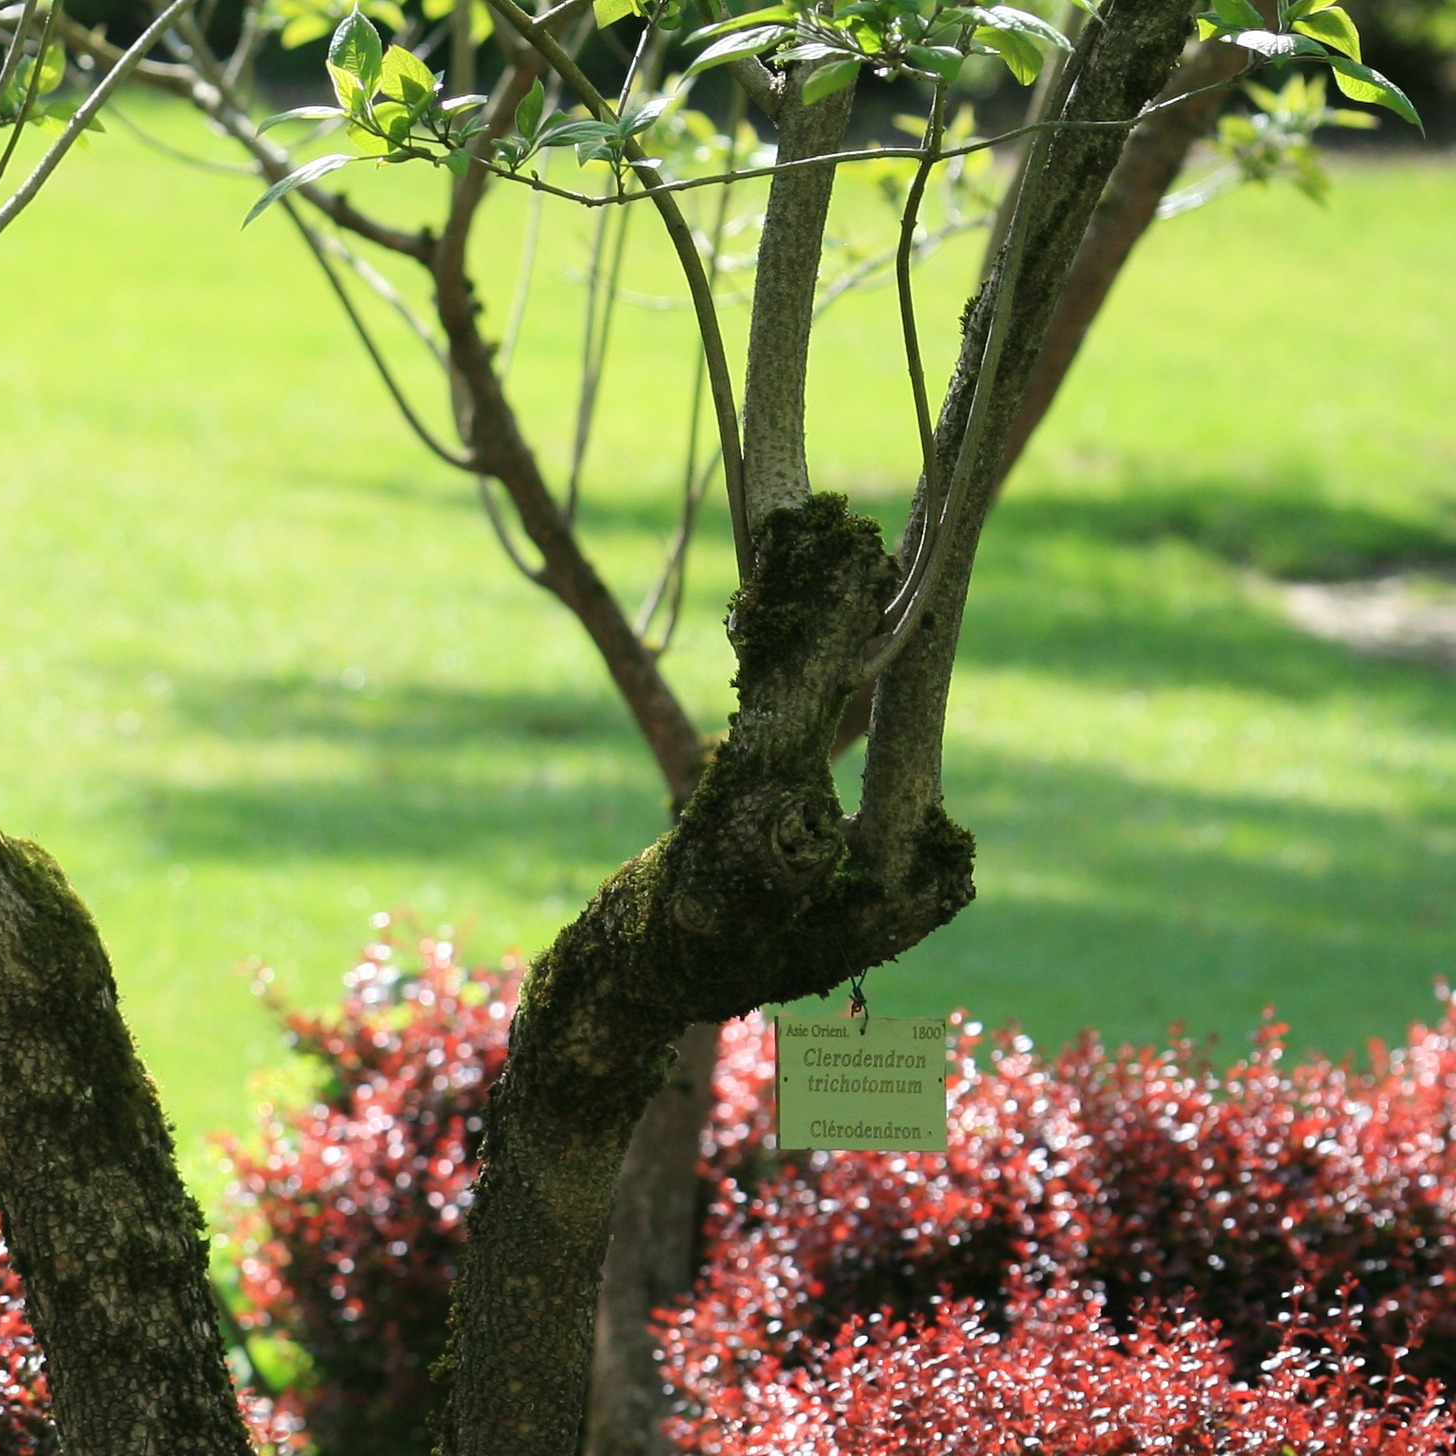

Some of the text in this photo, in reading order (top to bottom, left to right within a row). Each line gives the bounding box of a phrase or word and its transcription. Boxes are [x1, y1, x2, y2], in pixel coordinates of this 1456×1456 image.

[786, 1024, 809, 1038] Asie
[803, 1047, 926, 1069] Clerodendron
[808, 1073, 923, 1094] trichotomum
[810, 1119, 922, 1139] Clérodendron
